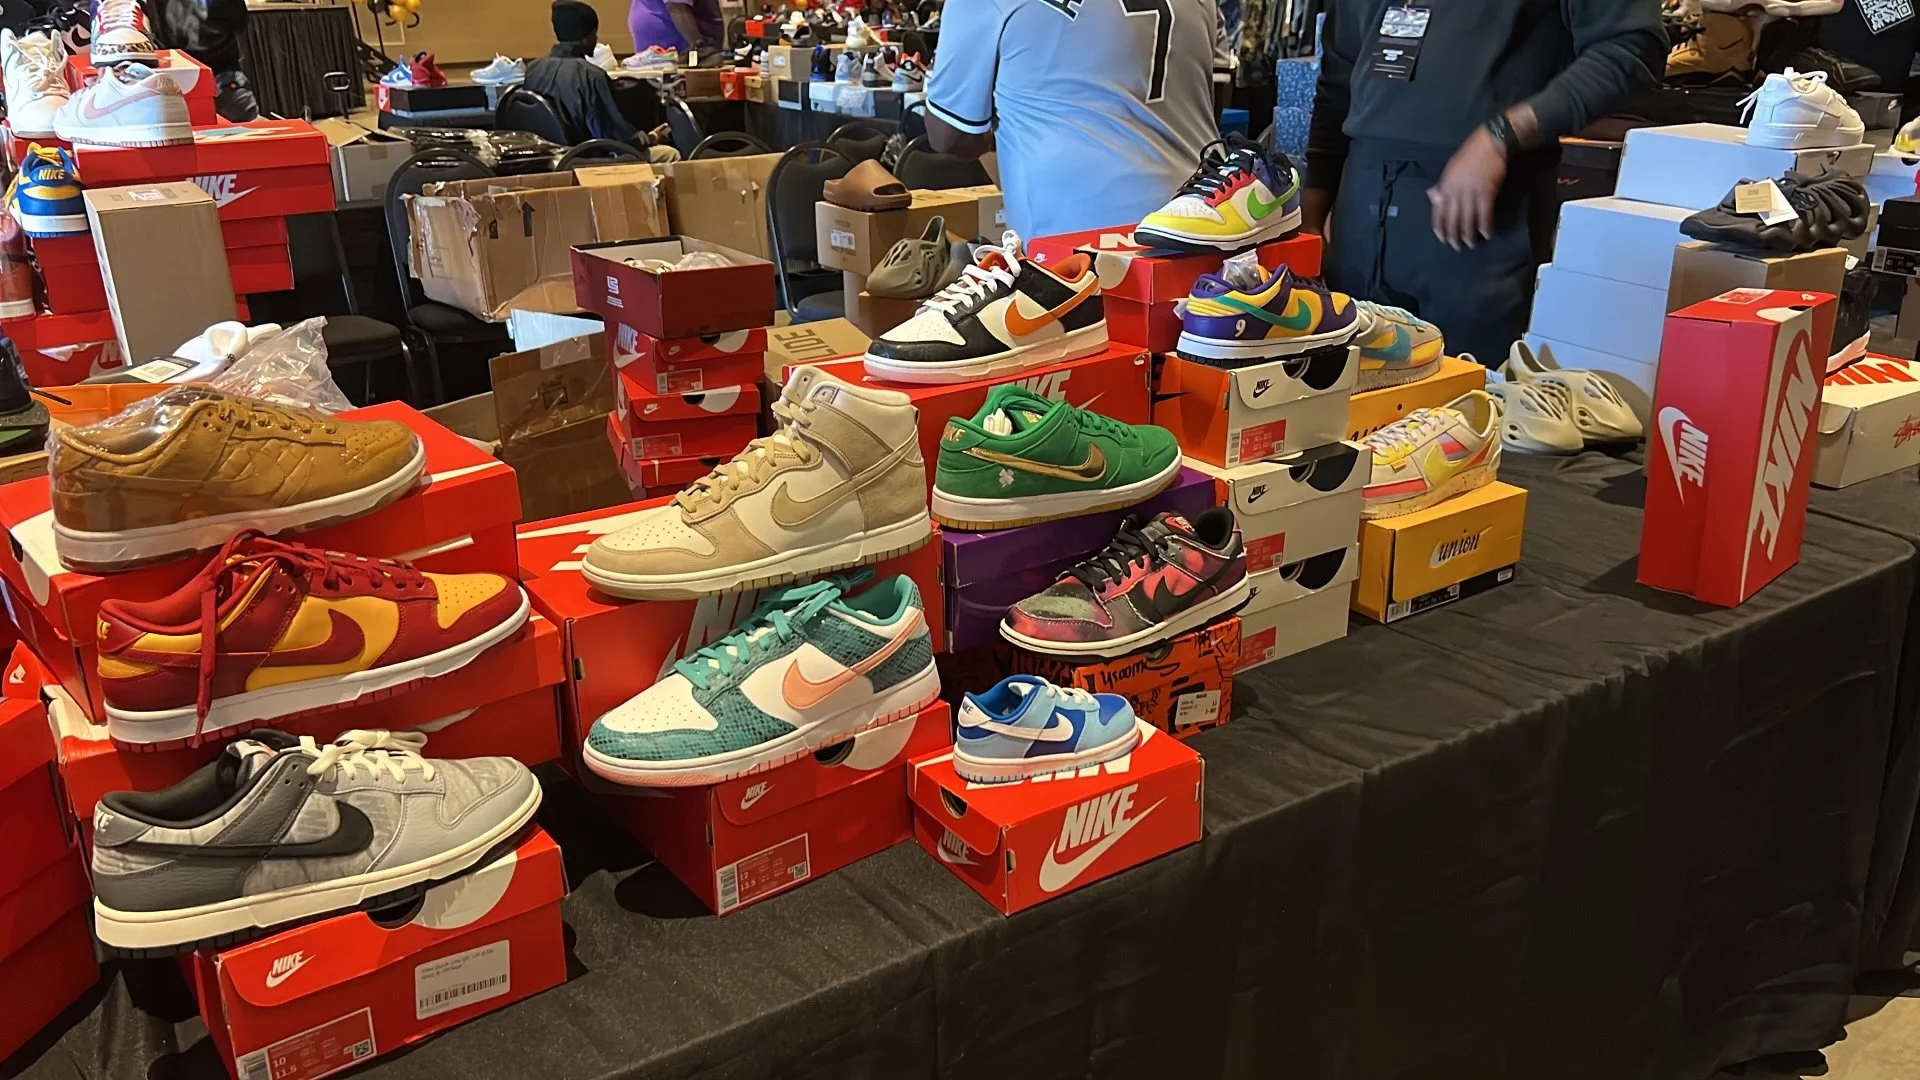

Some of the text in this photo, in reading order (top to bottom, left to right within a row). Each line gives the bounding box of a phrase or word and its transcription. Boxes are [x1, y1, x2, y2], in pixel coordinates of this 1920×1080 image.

[38, 169, 65, 180] NIKE
[186, 174, 237, 200] IKE
[618, 321, 639, 354] NIKE
[1235, 319, 1246, 337] 9
[983, 370, 1072, 402] KE
[1255, 378, 1270, 391] NIKE
[1679, 422, 1709, 487] NIKE
[1752, 338, 1818, 561] NIKE
[1251, 484, 1266, 496] NIKE
[1438, 529, 1480, 562] union
[745, 781, 768, 801] NIKE
[1056, 783, 1138, 854] NIKE
[272, 950, 304, 976] NIKE
[273, 1056, 287, 1068] 10
